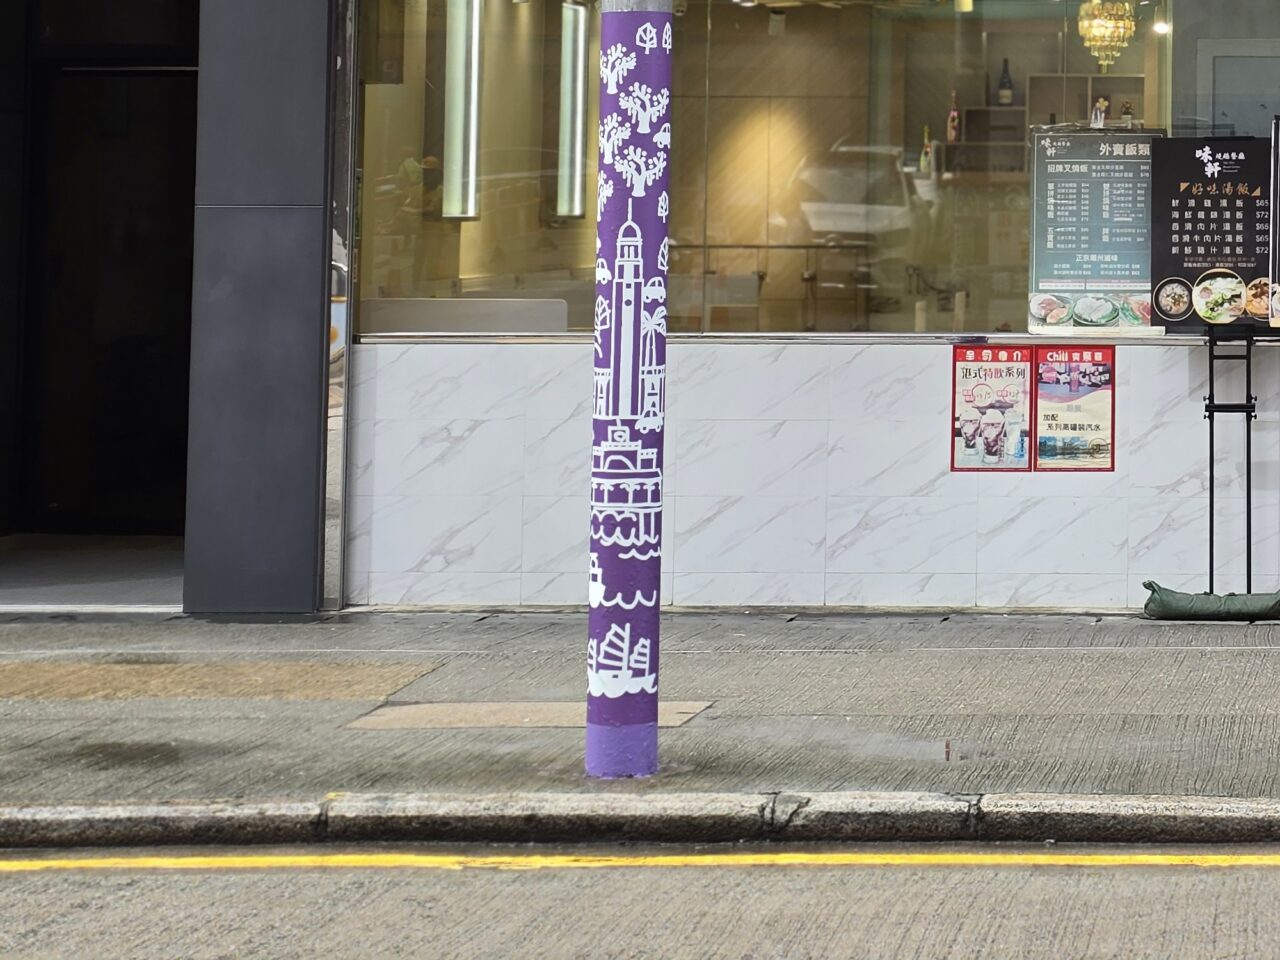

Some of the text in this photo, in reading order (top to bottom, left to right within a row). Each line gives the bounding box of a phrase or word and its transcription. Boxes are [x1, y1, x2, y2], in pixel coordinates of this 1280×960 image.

[1099, 143, 1151, 155] 外賣飯類
[1195, 145, 1221, 178] 味軒
[1047, 350, 1068, 361] Chill
